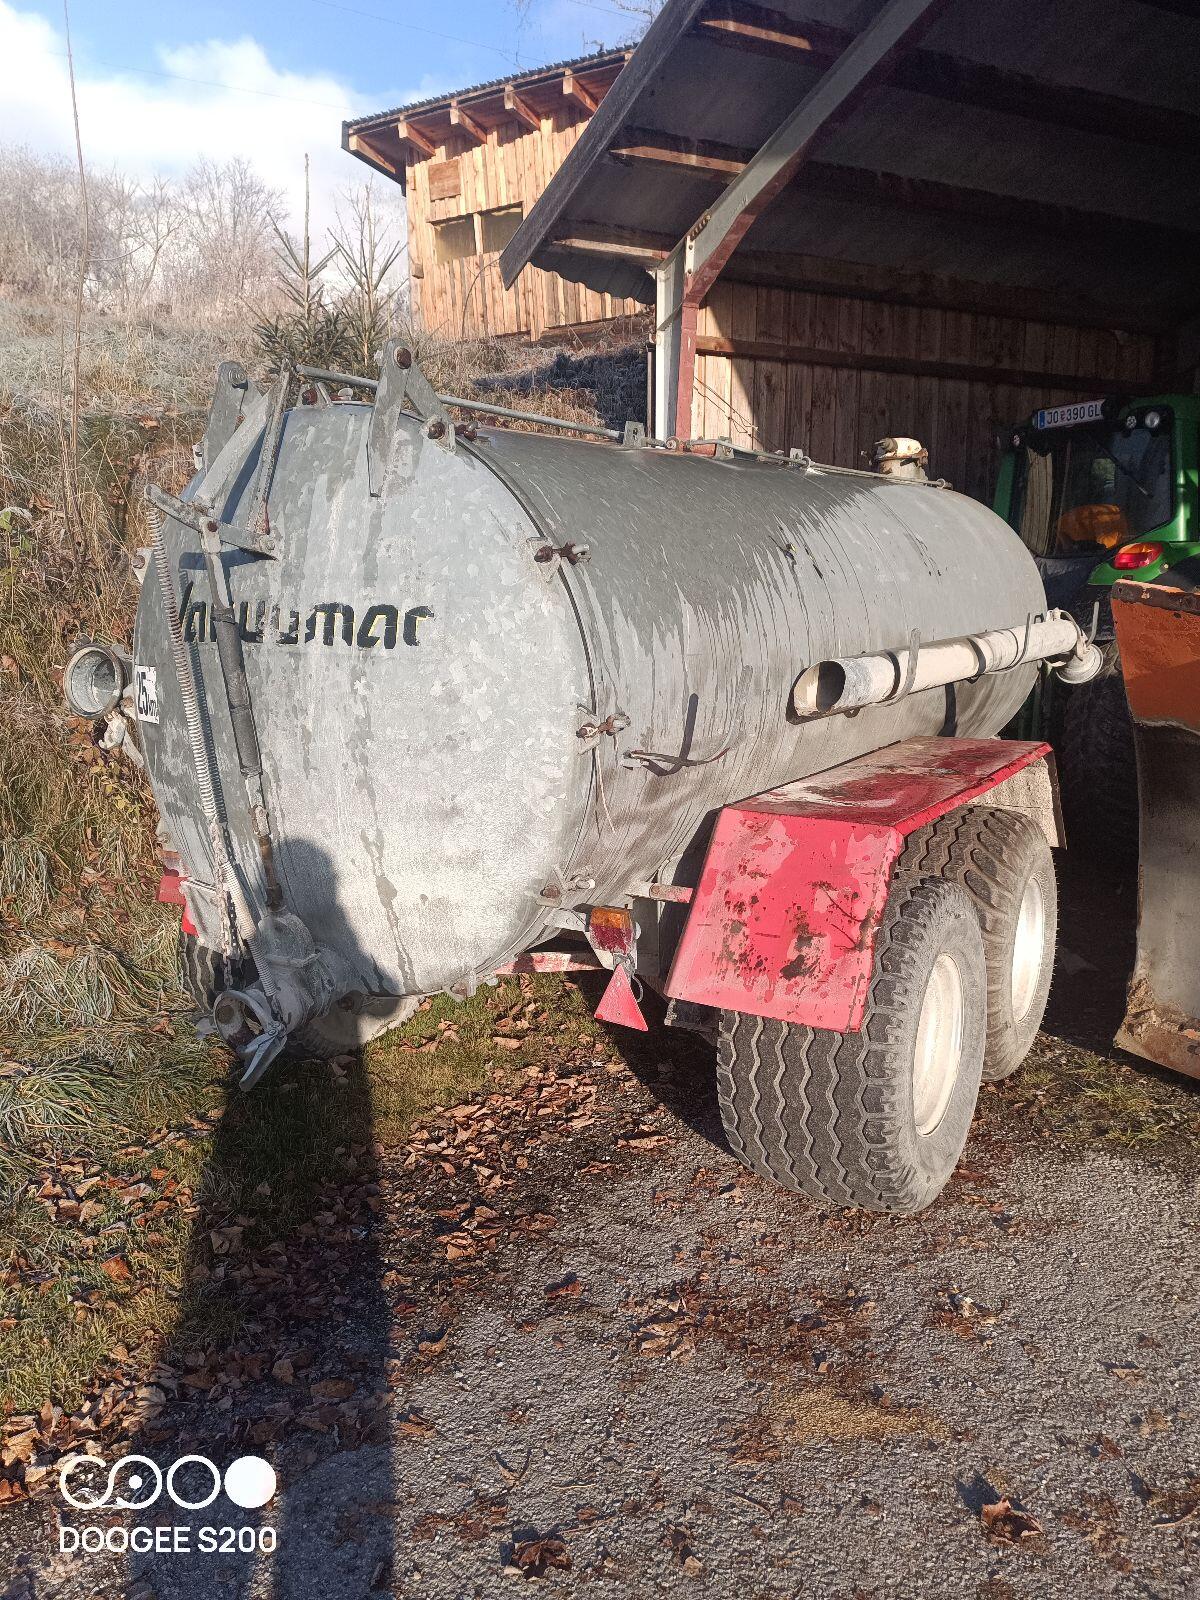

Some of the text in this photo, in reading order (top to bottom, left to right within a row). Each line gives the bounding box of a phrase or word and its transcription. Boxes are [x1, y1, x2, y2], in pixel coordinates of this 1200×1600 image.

[1047, 404, 1100, 425] JO 390 GL
